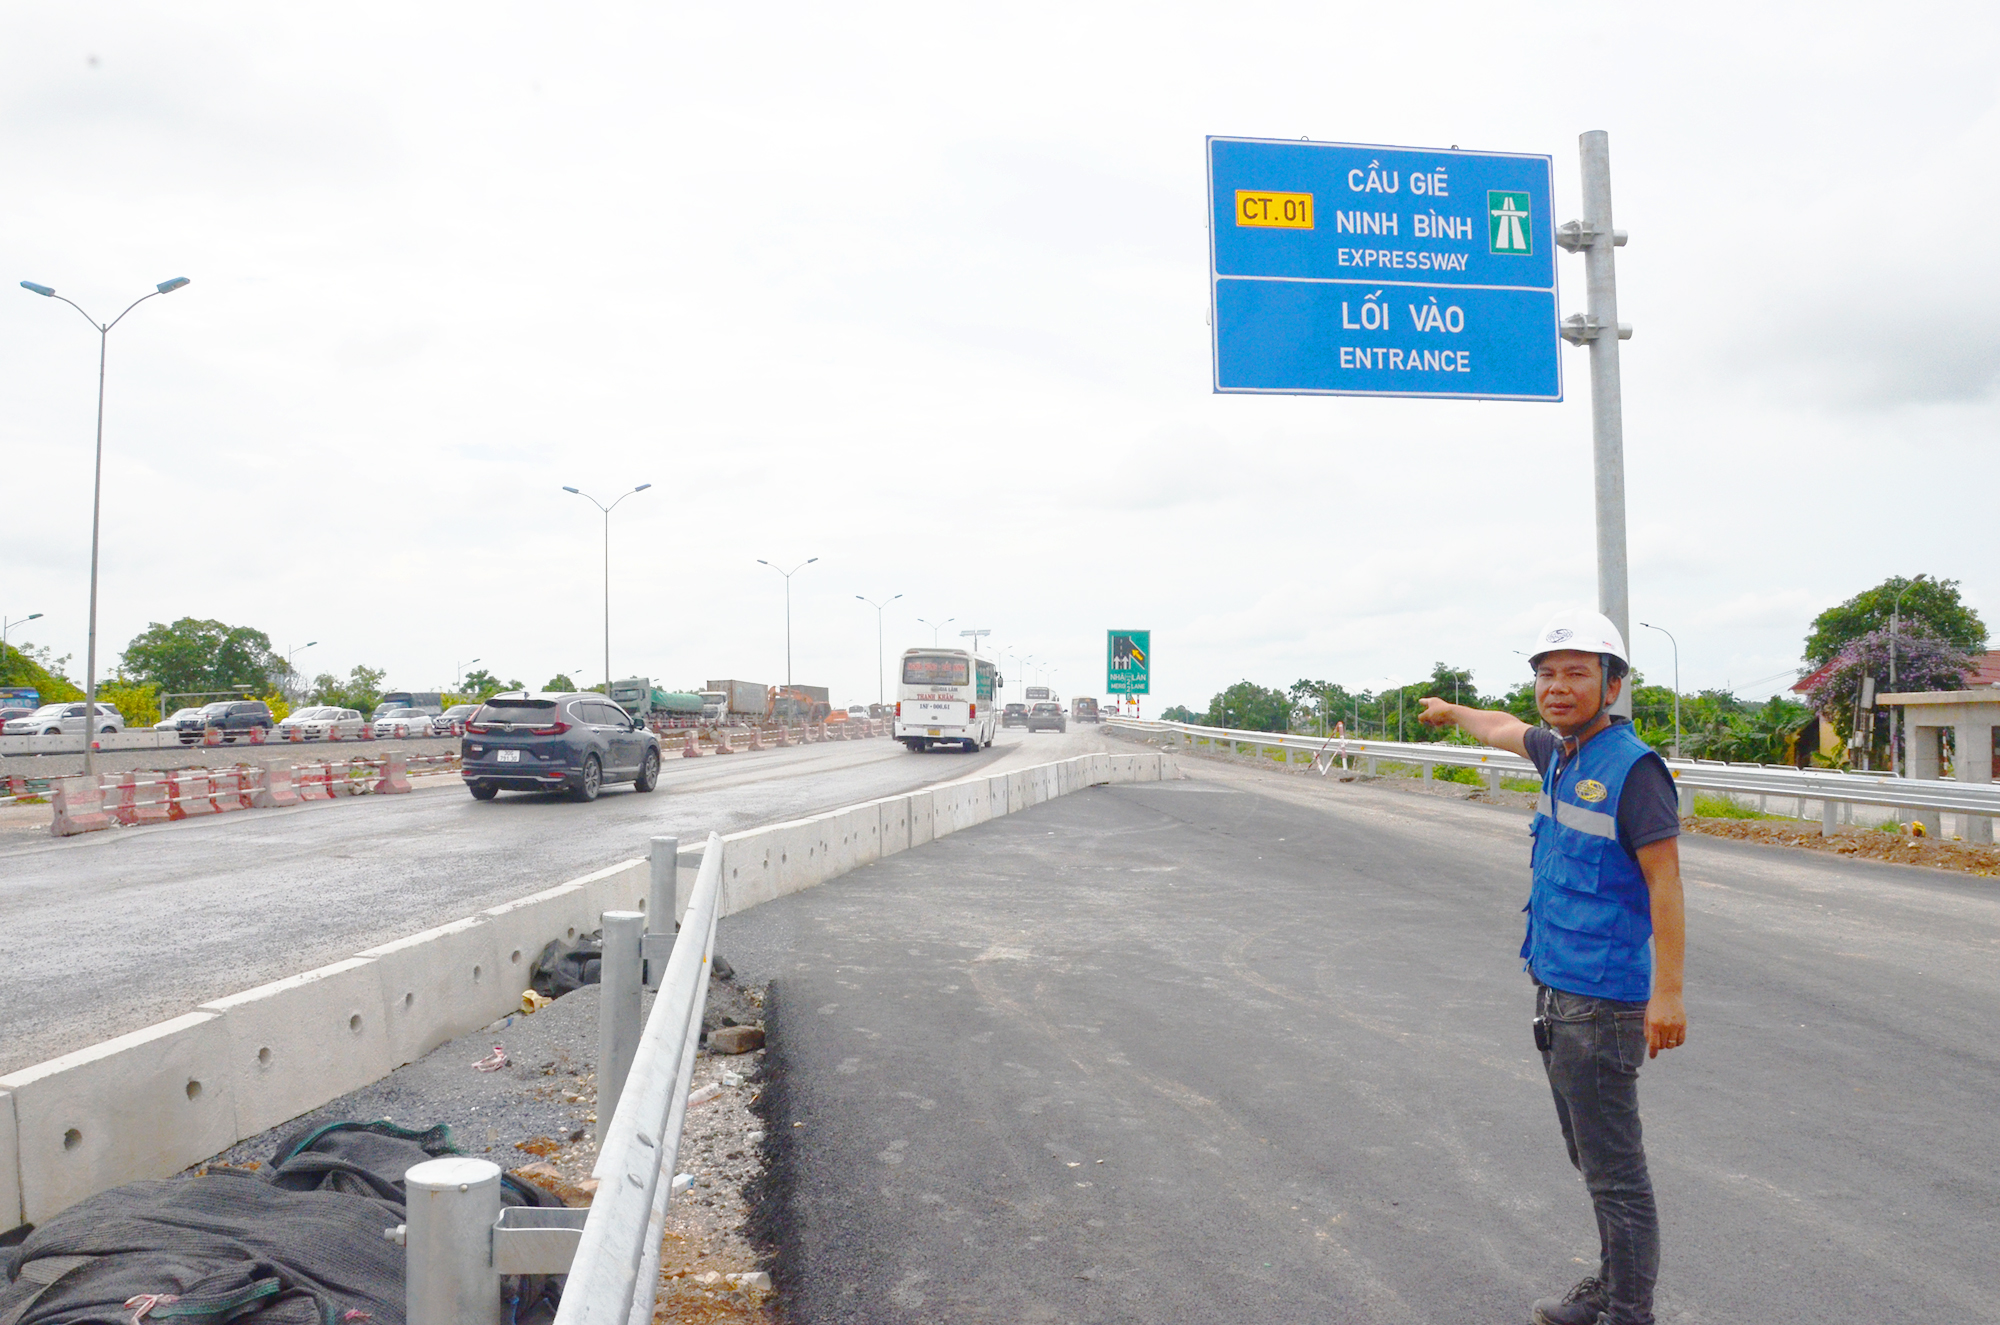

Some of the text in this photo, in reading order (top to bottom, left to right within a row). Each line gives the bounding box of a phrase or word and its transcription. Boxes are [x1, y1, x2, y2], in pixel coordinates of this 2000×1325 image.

[1348, 159, 1449, 197] CẦU GIẼ
[1242, 198, 1307, 223] CT.01
[1336, 209, 1473, 240] NINH BÌNH
[1338, 248, 1469, 271] EXPRESSWAY
[1342, 290, 1464, 333] LỐI VÀO
[1340, 347, 1471, 372] ENTRANCE
[1110, 672, 1126, 682] NHẬ
